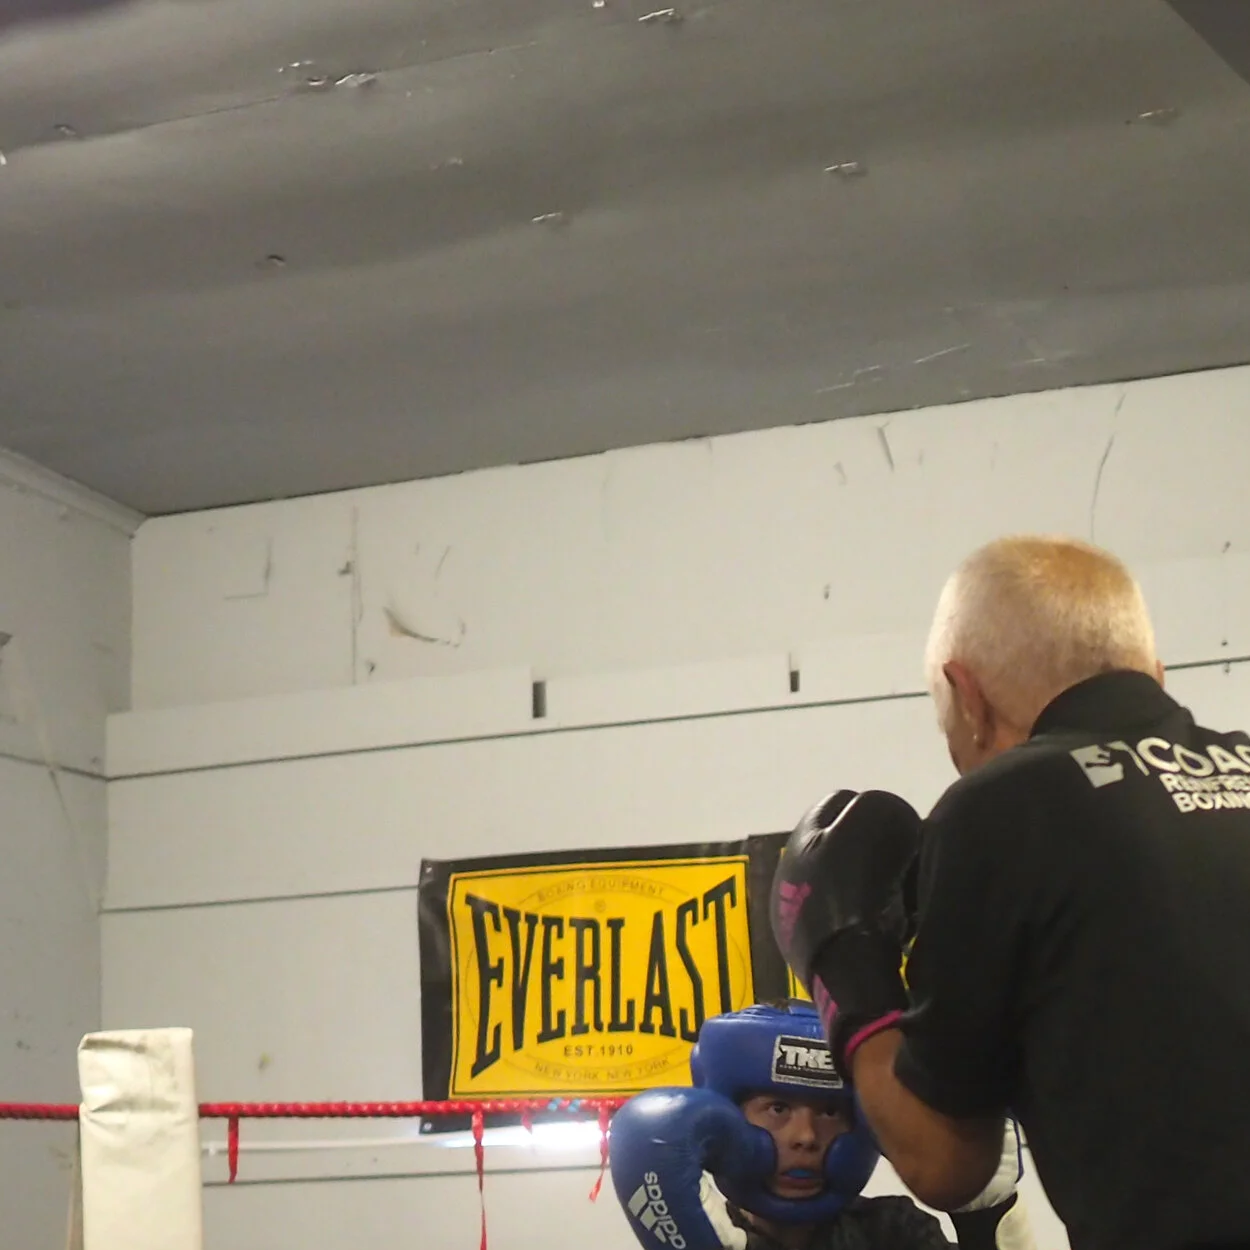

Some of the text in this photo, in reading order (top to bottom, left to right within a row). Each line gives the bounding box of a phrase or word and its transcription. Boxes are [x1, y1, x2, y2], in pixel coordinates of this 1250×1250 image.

[465, 875, 737, 1080] EVERLAST
[600, 1044, 634, 1056] 1910
[644, 1171, 687, 1250] adidas
